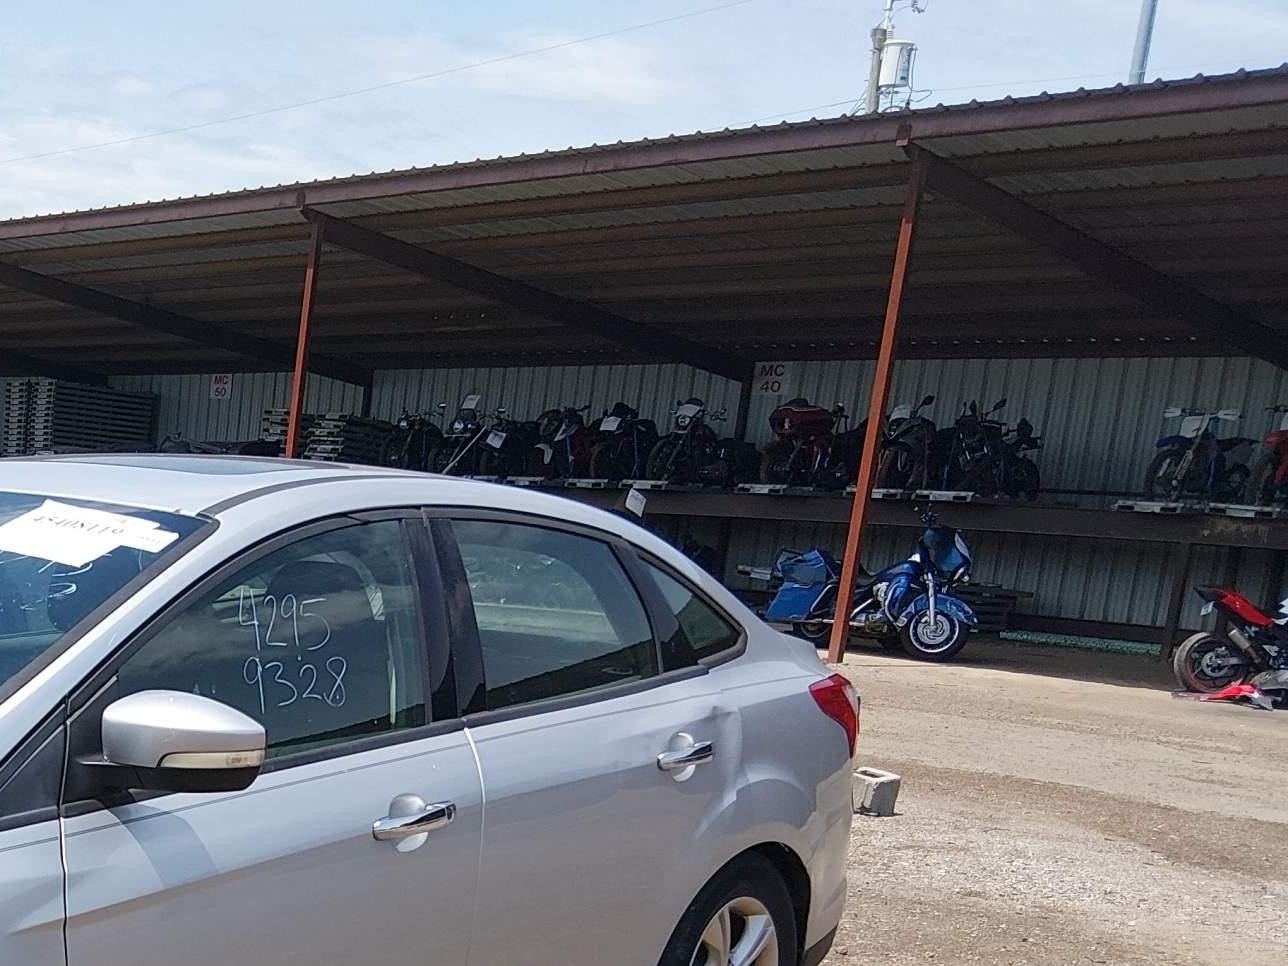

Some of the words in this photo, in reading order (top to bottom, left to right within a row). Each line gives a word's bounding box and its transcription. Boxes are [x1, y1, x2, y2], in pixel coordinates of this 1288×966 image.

[760, 364, 785, 377] MC
[214, 374, 229, 385] MC
[759, 380, 781, 393] 40
[238, 586, 331, 651] 4295
[243, 656, 347, 714] 9328
